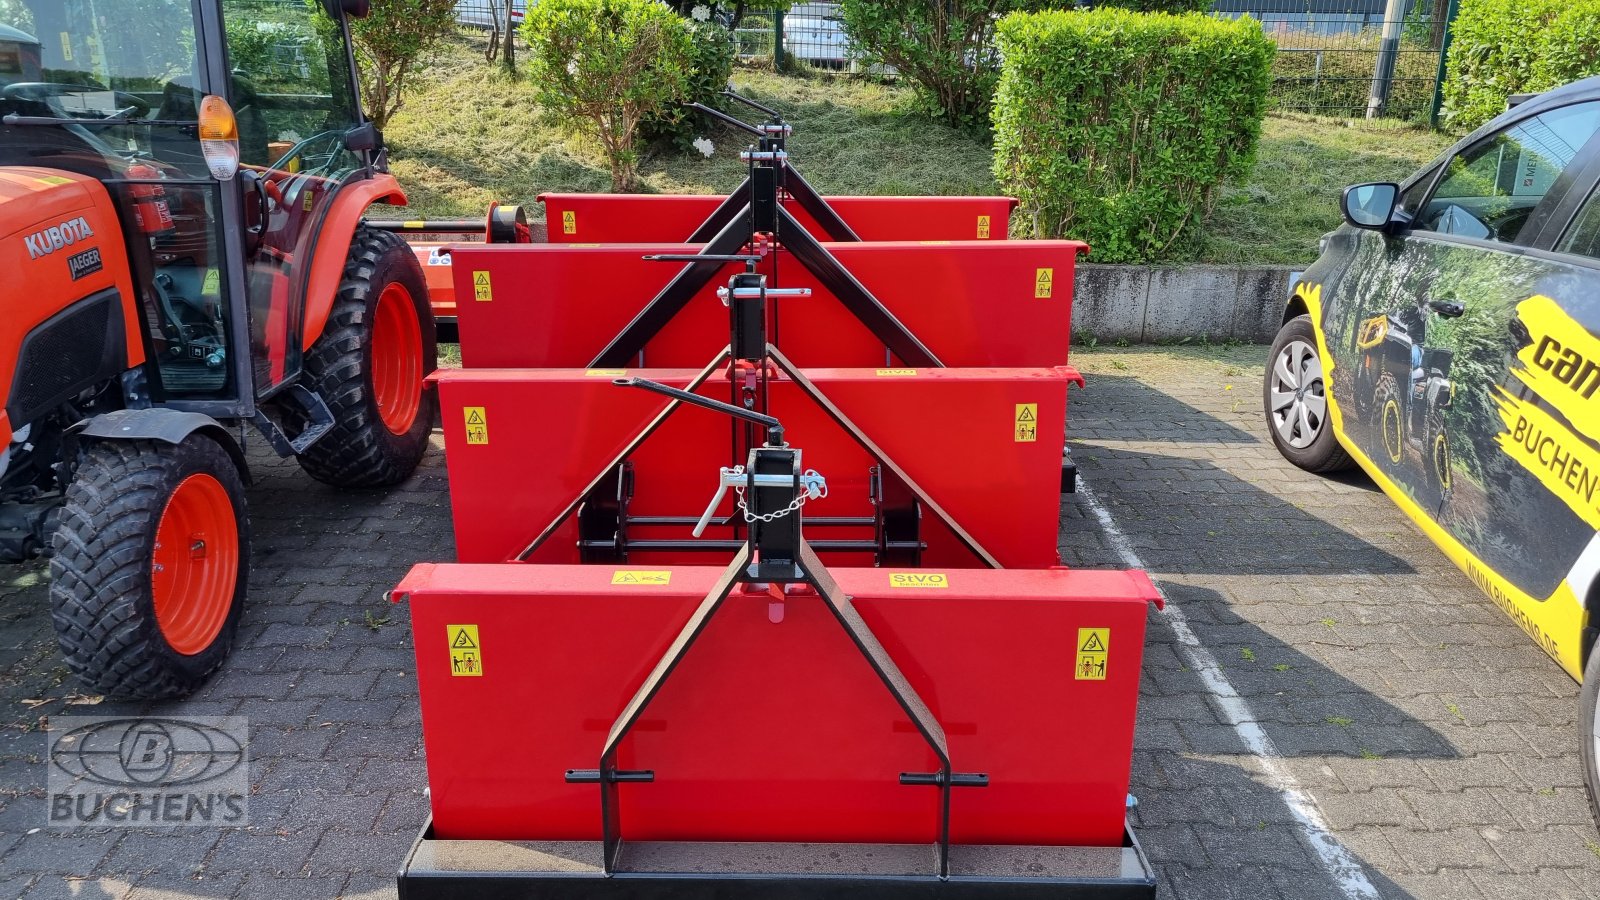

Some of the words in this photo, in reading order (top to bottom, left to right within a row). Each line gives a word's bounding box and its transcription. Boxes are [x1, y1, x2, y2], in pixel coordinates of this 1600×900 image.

[24, 216, 94, 260] KUBOTA
[69, 249, 101, 280] JAEGER
[1513, 414, 1600, 515] BUCHEN
[893, 574, 944, 583] StVO
